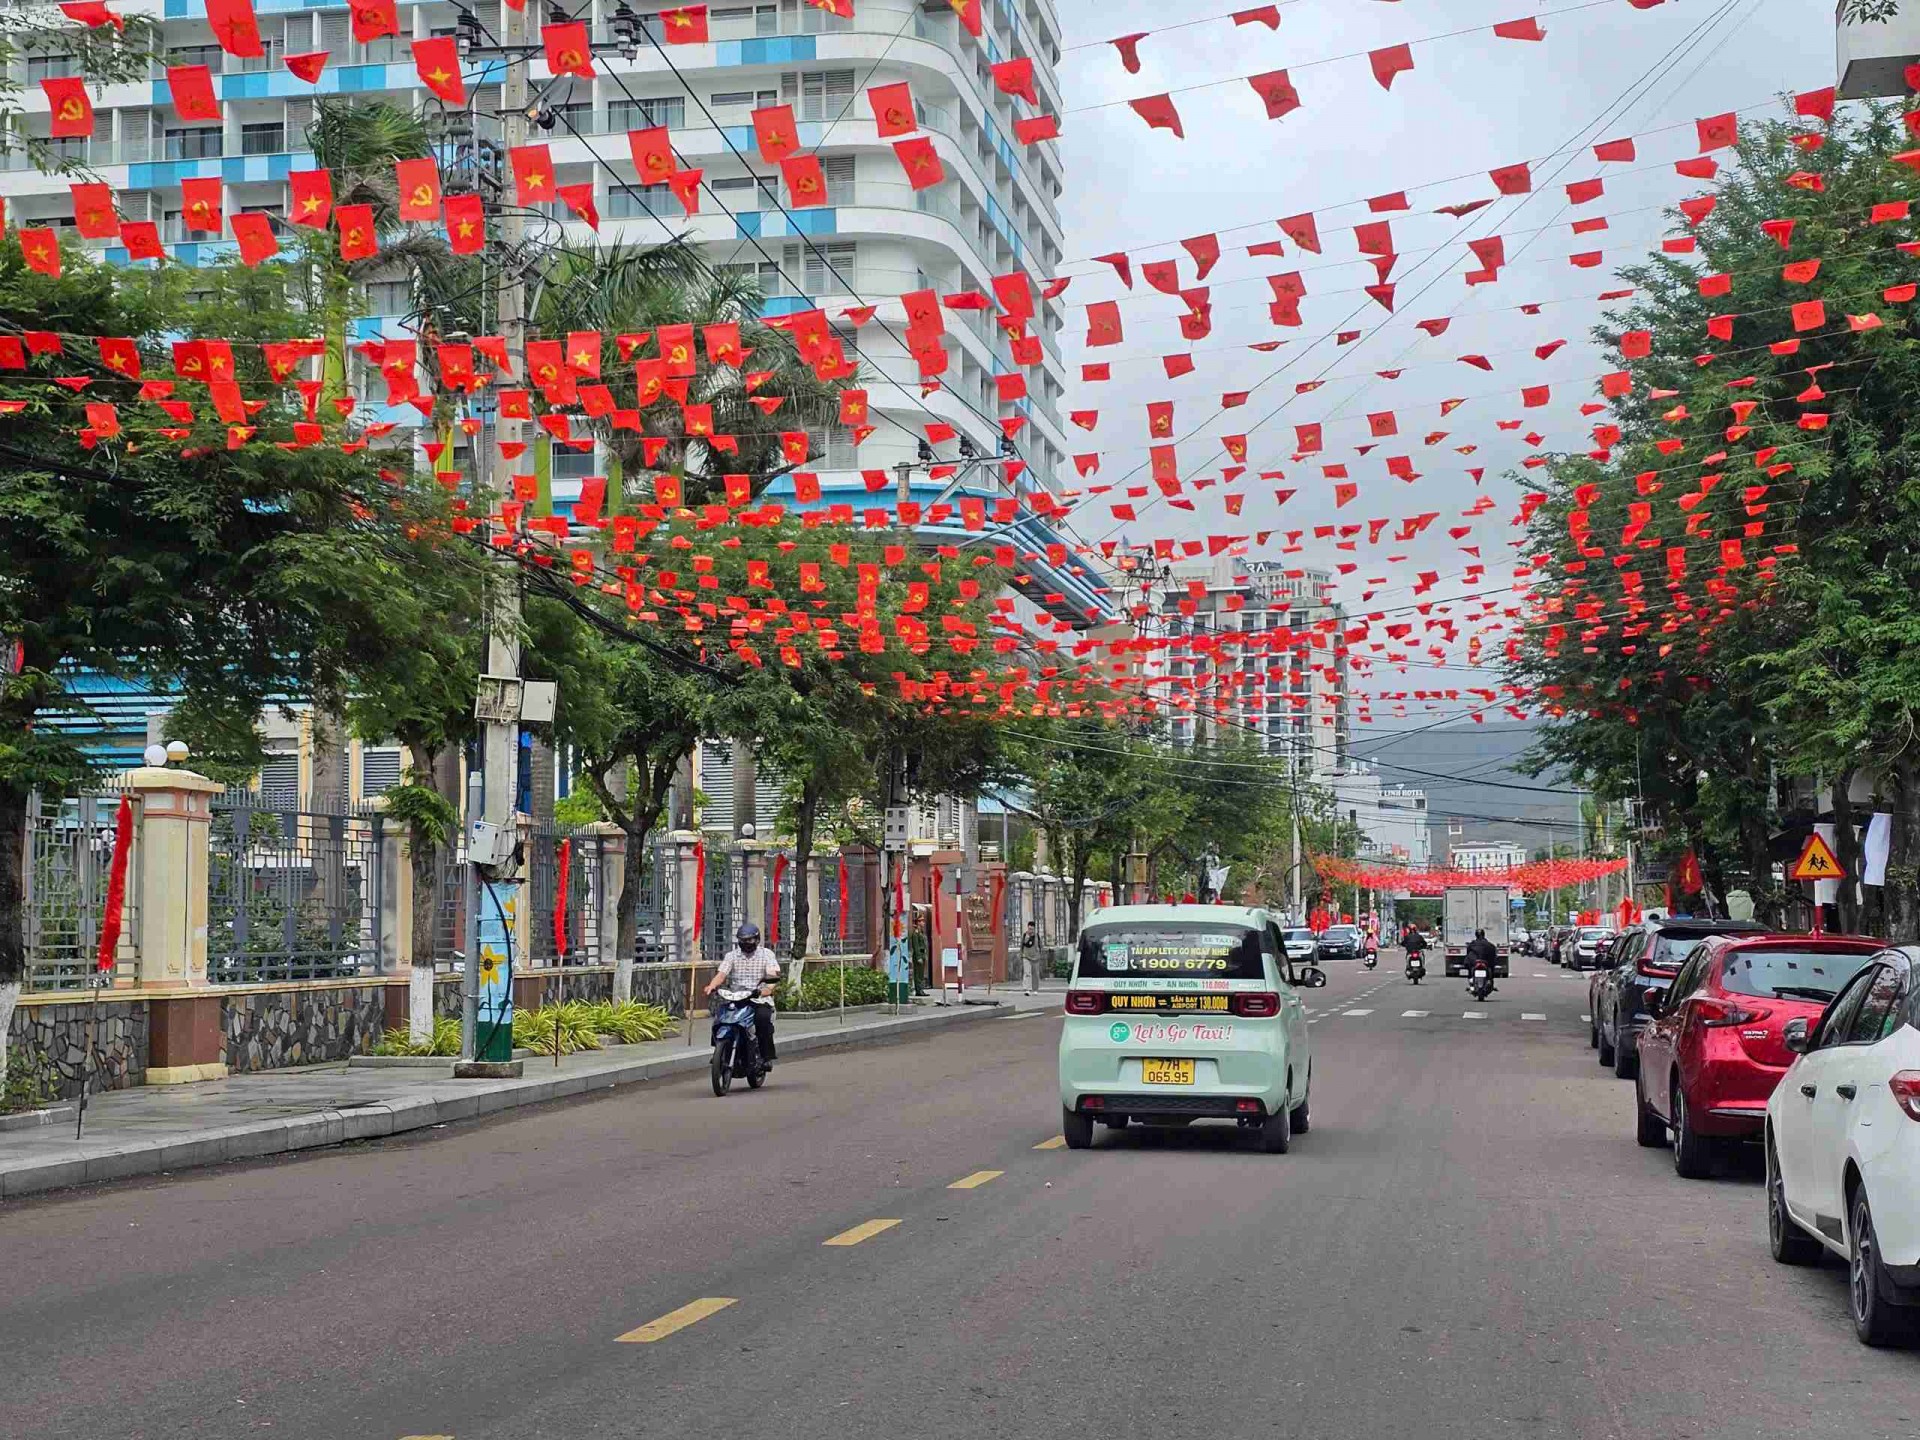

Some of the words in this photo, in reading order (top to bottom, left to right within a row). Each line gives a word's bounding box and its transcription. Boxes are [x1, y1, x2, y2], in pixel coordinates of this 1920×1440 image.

[1143, 947, 1158, 955] APP
[1159, 947, 1178, 955] LET'S
[1179, 947, 1190, 955] GO
[1139, 959, 1180, 969] 1900
[1184, 959, 1227, 970] 6779
[1113, 980, 1126, 989] QUY
[1166, 980, 1177, 988] AN
[1111, 996, 1128, 1008] QUY
[1134, 1024, 1164, 1043] Let's
[1167, 1024, 1188, 1042] Go
[1158, 1059, 1180, 1071] 77H
[1148, 1071, 1189, 1083] 065.95
